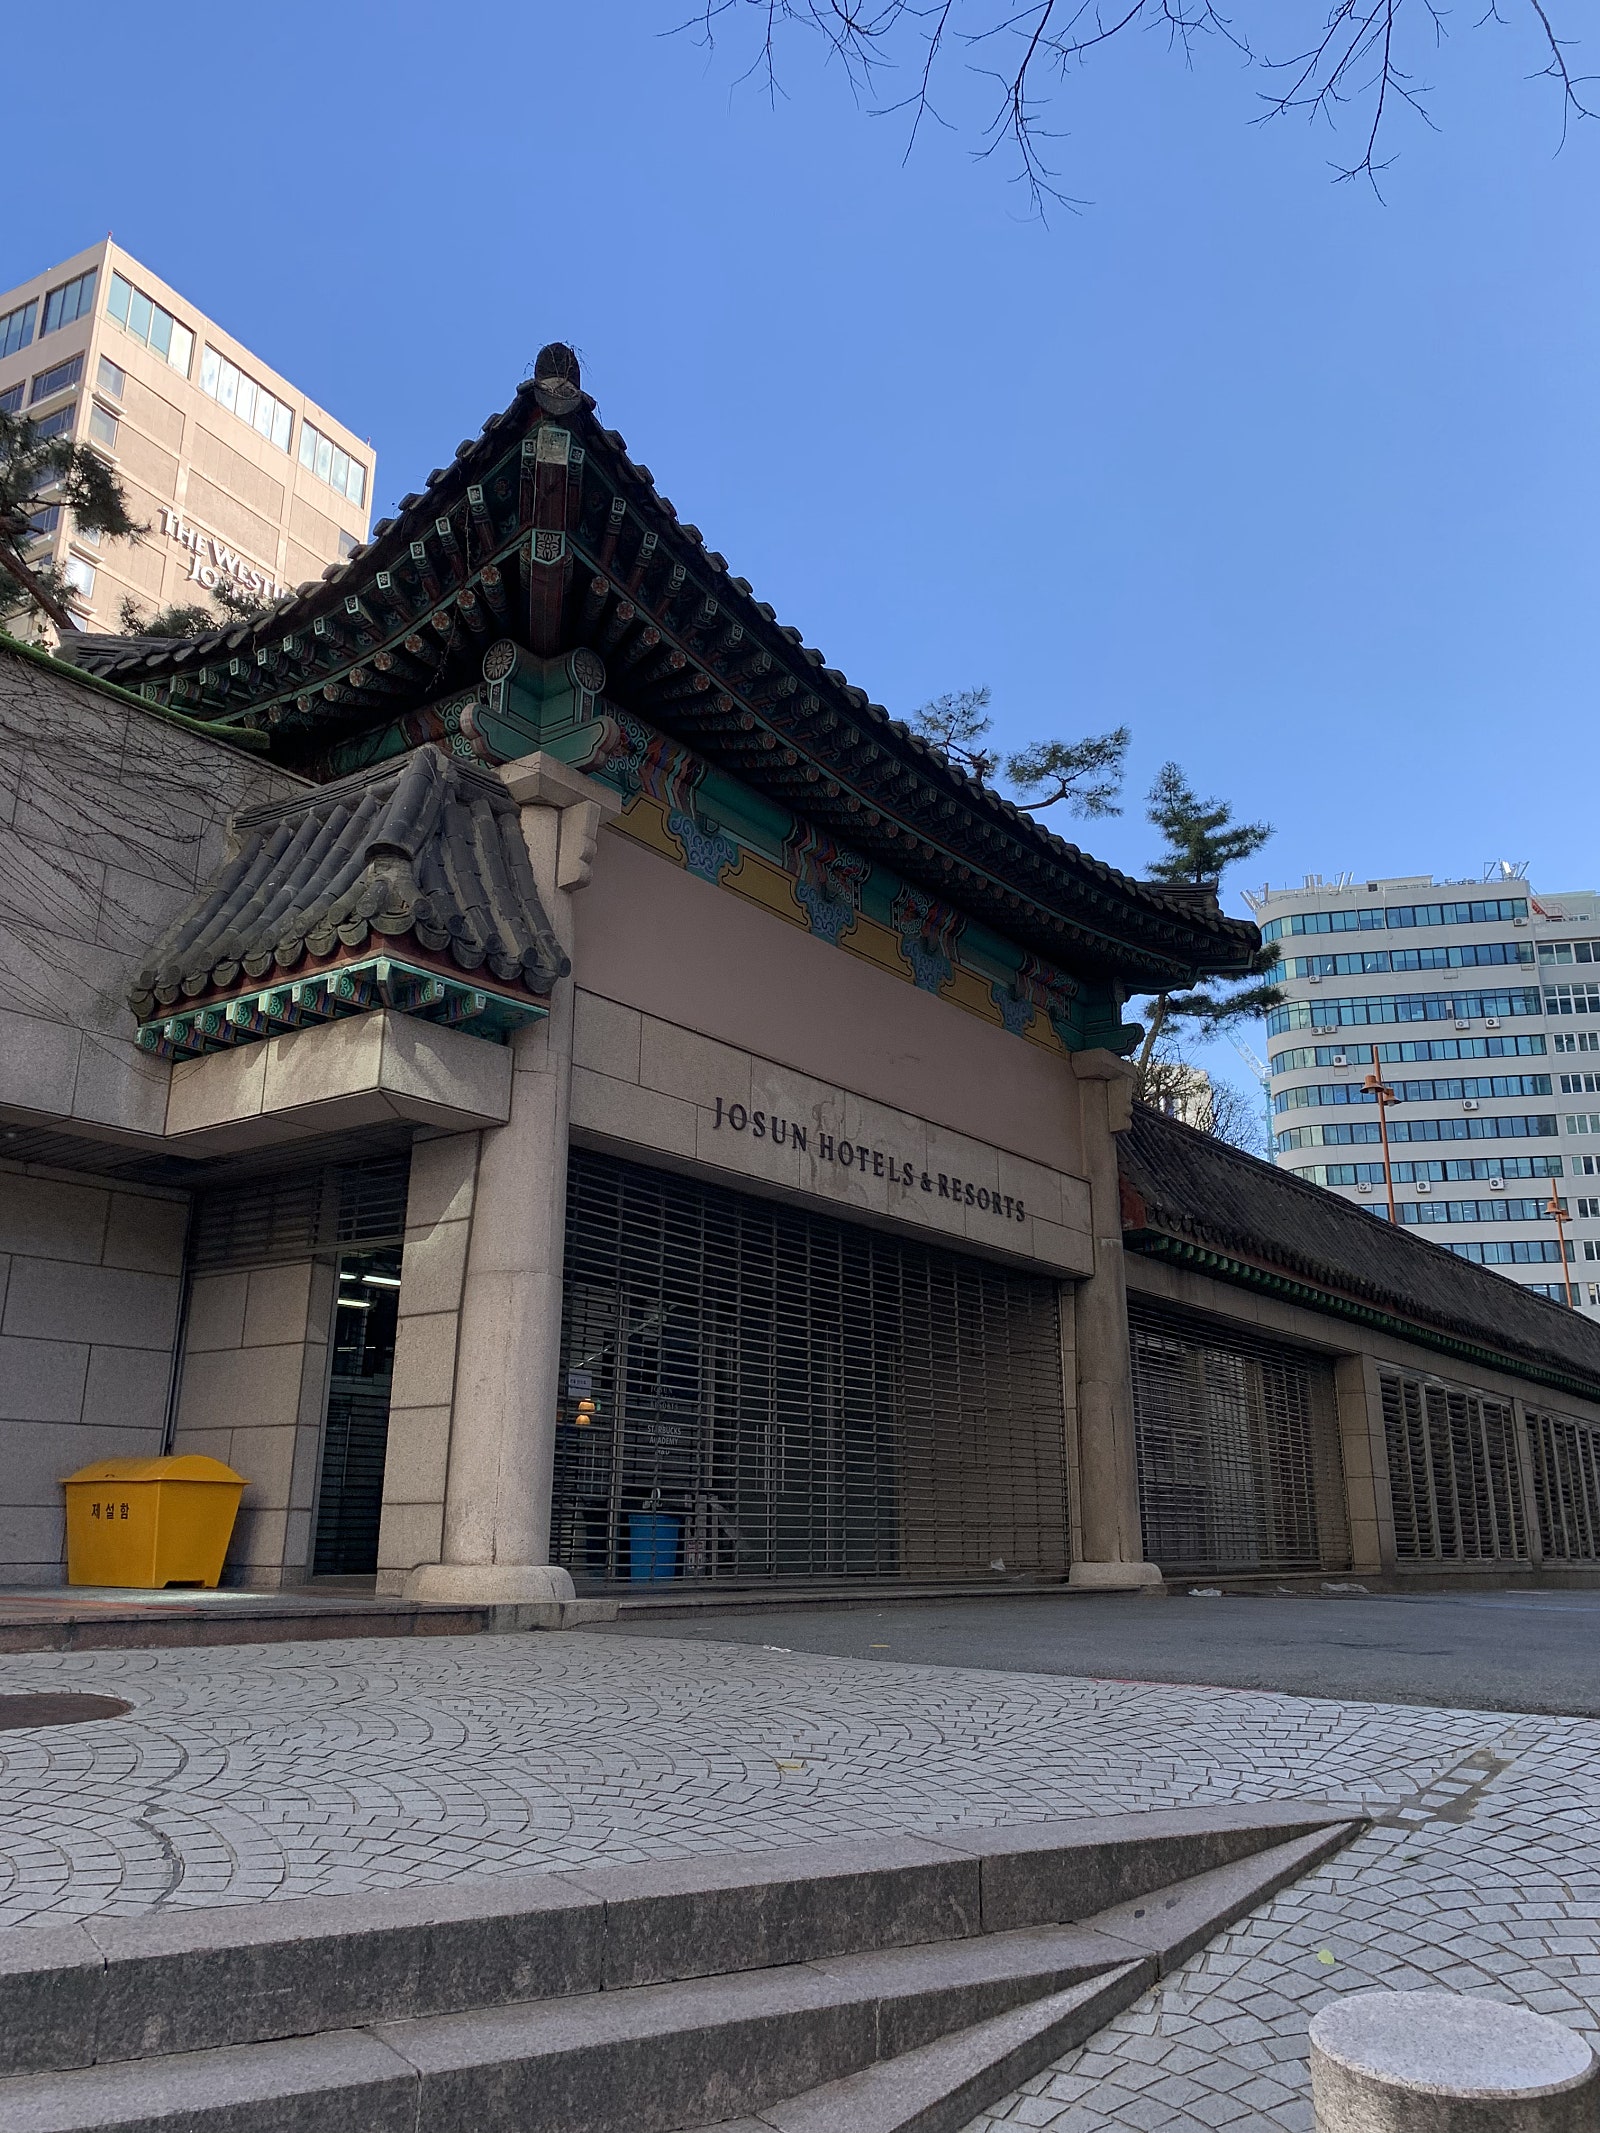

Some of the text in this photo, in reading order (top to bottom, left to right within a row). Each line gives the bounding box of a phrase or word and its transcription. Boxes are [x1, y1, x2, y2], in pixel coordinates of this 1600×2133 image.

[160, 506, 207, 556] THE
[209, 538, 286, 599] WESTI
[713, 1097, 1026, 1223] JOSUN HOTELS & RESORTS
[91, 1503, 130, 1520] 제설함
